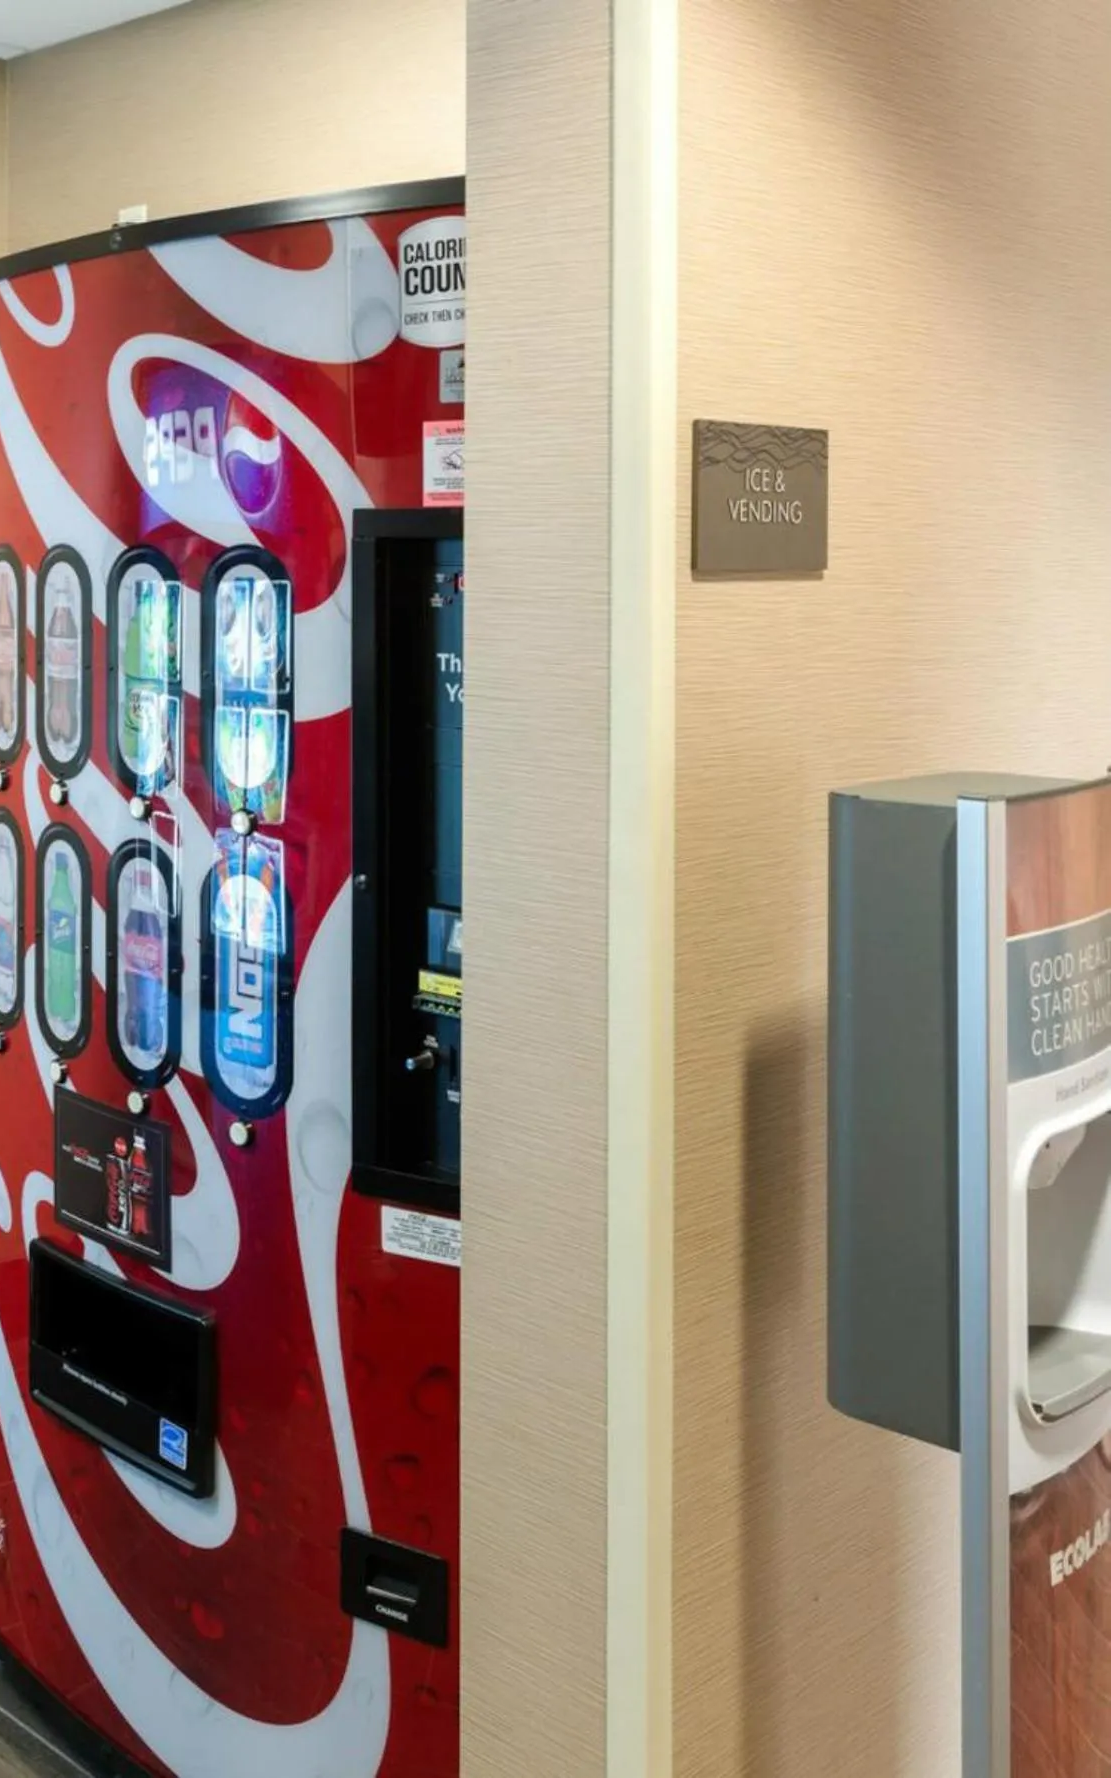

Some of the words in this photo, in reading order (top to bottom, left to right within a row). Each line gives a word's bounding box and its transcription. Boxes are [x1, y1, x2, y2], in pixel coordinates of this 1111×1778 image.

[404, 236, 466, 265] CALORI
[404, 312, 429, 326] CHECK
[432, 308, 453, 323] THEN
[745, 467, 771, 492] ICE
[775, 469, 786, 493] &
[728, 498, 803, 524] VENDING
[1030, 952, 1074, 988] GOOD
[1031, 981, 1089, 1022] STARTS
[1031, 1016, 1083, 1056] CLEAN
